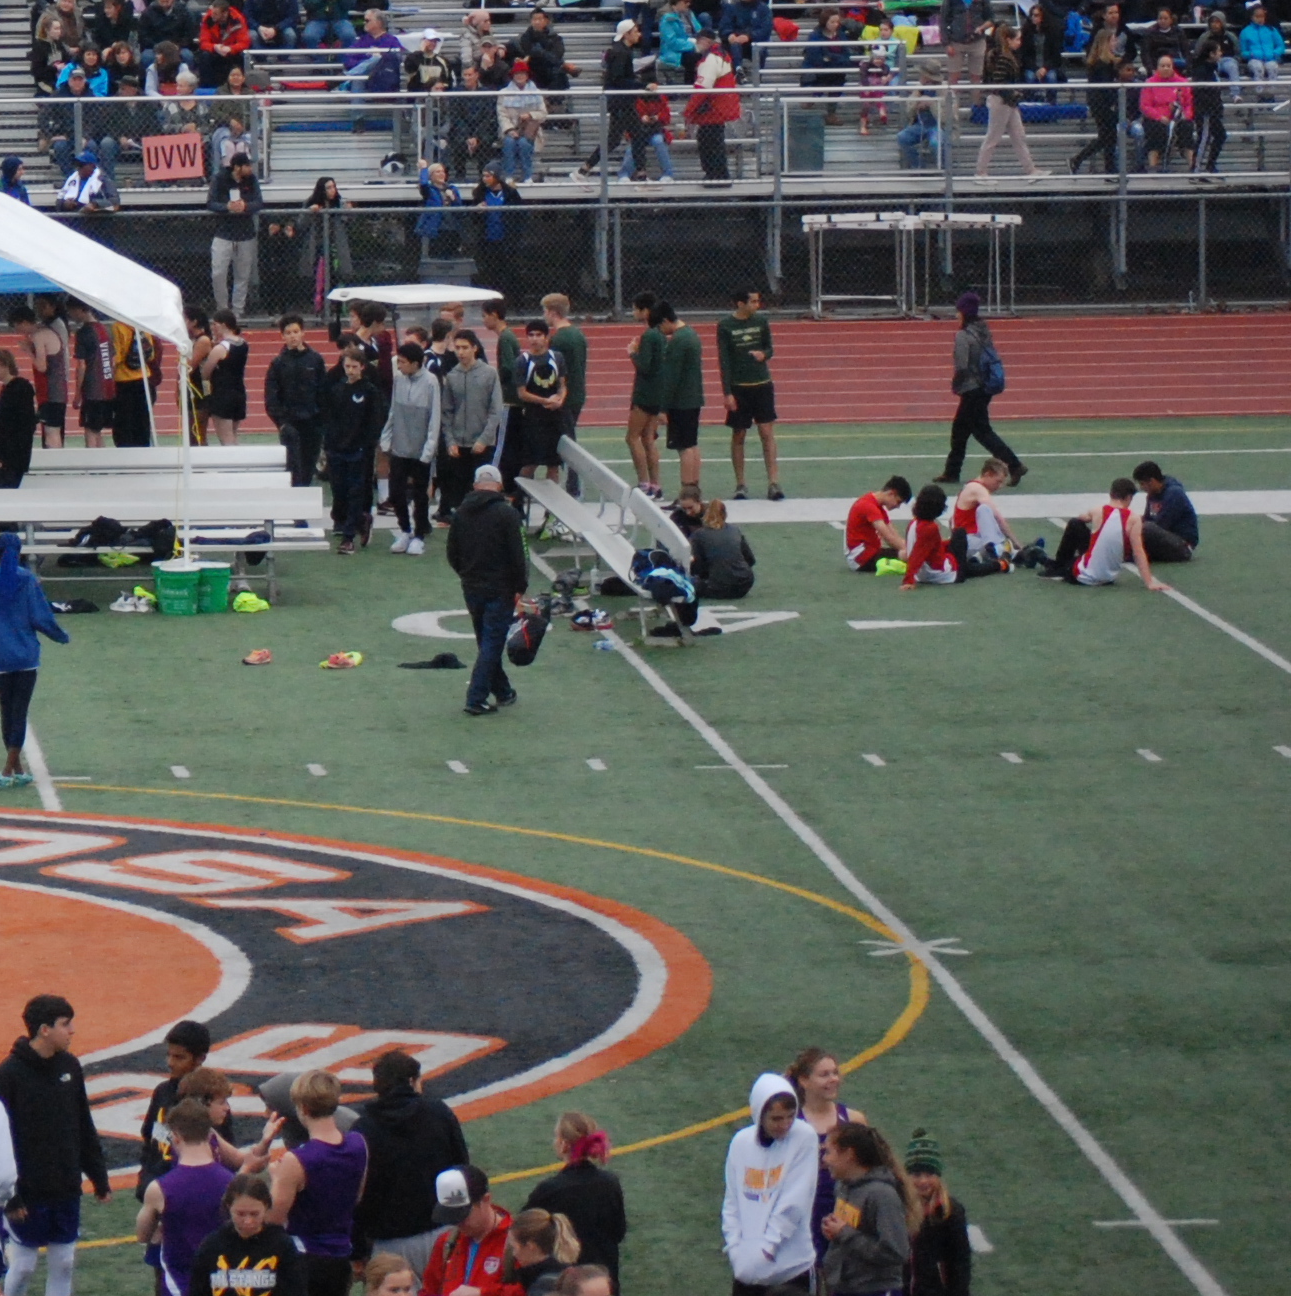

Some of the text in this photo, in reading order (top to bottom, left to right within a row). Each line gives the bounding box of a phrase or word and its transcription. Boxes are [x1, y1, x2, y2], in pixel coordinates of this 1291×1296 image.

[145, 142, 197, 171] UVW
[99, 340, 113, 380] VIKINGS
[209, 1268, 277, 1289] MUSTANGS
